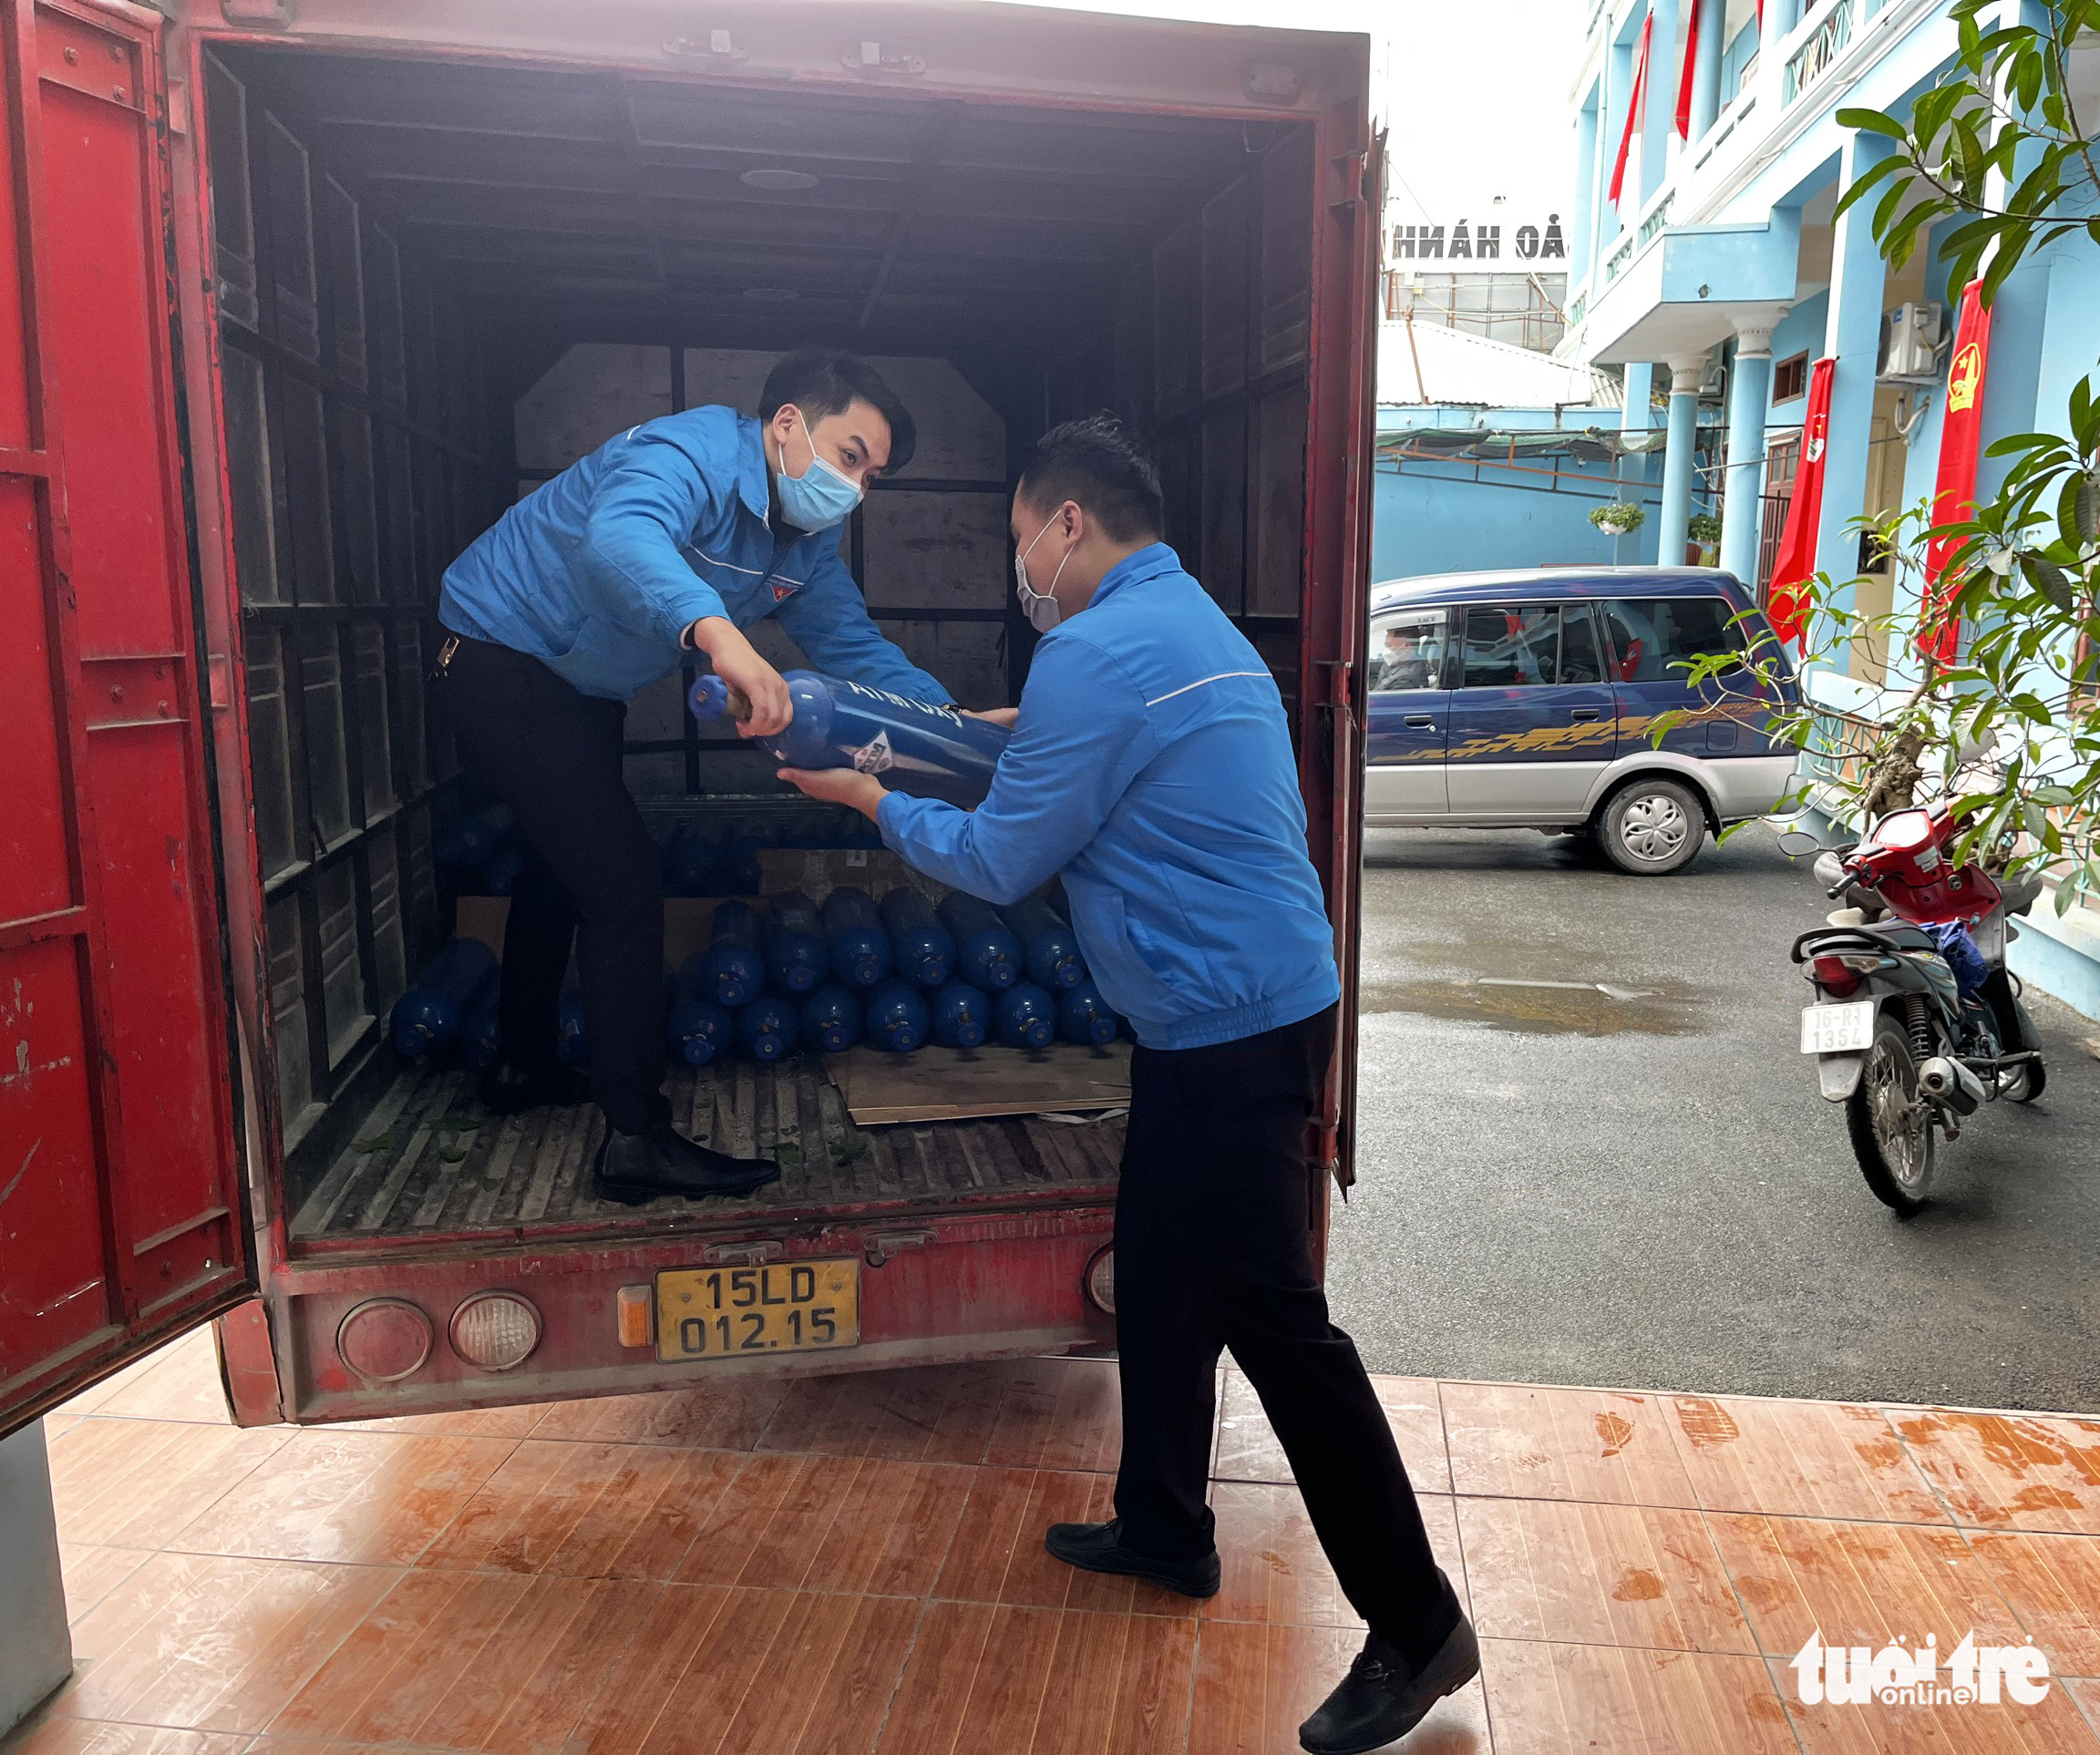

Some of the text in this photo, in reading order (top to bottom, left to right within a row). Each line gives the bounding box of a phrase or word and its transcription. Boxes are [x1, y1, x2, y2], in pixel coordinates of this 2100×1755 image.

[1417, 616, 1436, 624] ZACE
[1814, 1028, 1862, 1050] 1354
[706, 1266, 815, 1309] 15LD
[680, 1307, 836, 1354] 012.15
